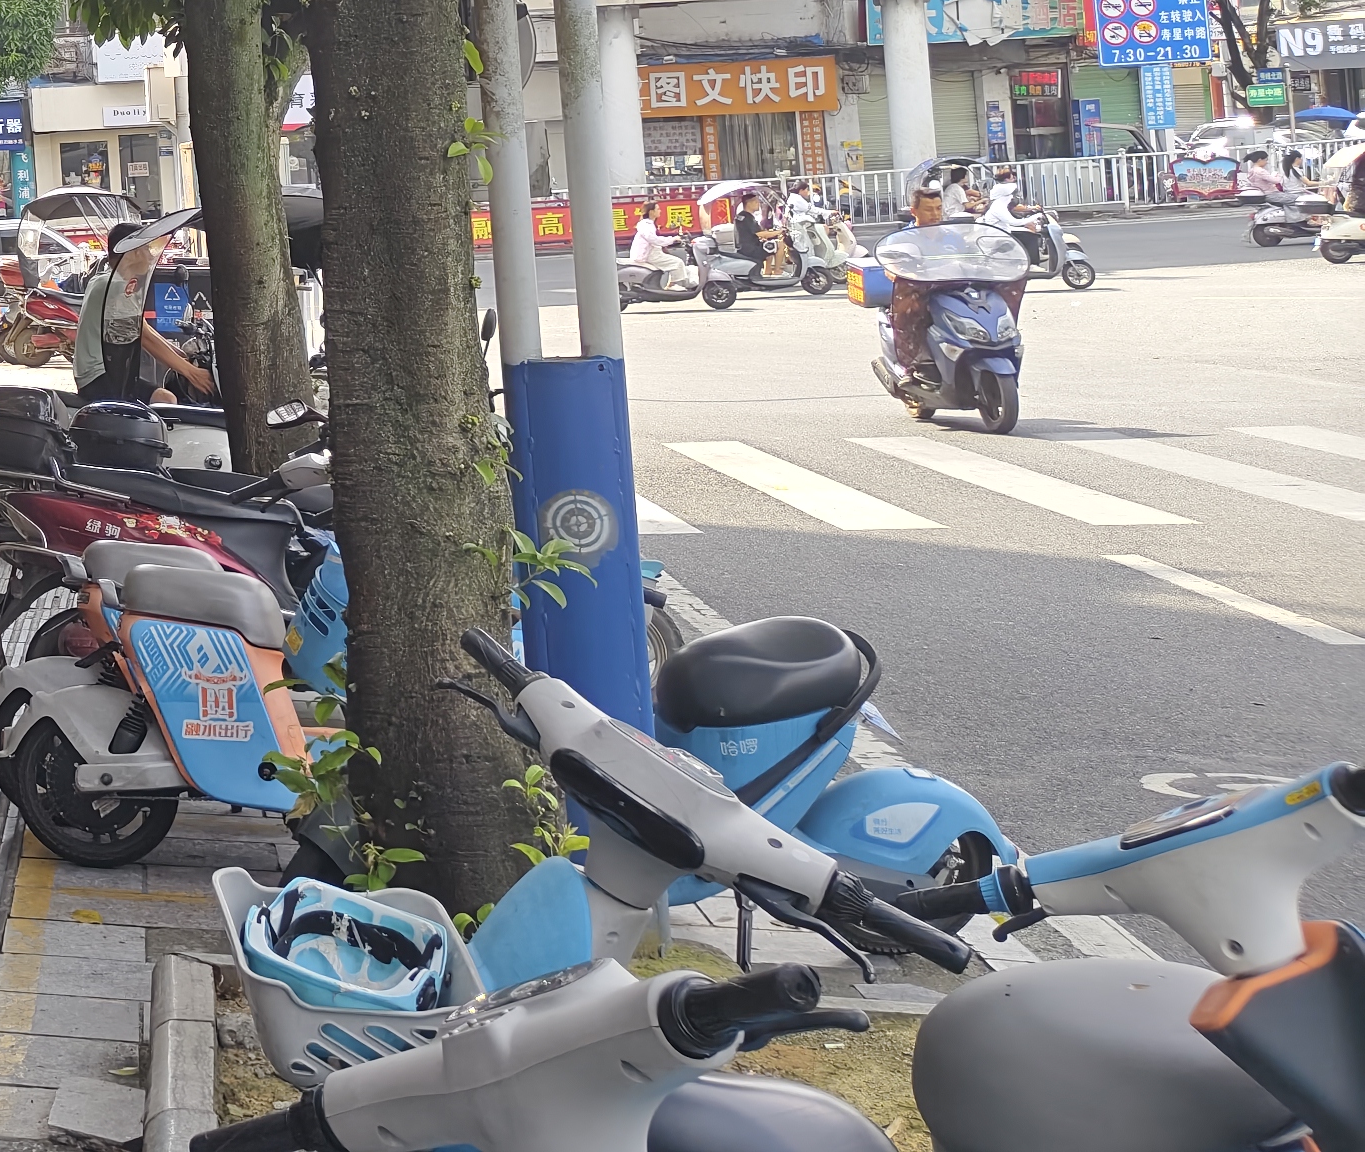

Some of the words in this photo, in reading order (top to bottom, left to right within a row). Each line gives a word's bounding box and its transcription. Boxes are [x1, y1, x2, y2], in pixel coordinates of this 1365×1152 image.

[1159, 10, 1204, 23] 左转驶入
[1161, 27, 1206, 41] 寿星中路
[1278, 28, 1324, 57] N9
[1112, 45, 1199, 62] 7:30-21:30
[649, 65, 826, 108] 图文快印
[85, 518, 121, 538] 绿驹
[184, 722, 252, 739] 融水出行
